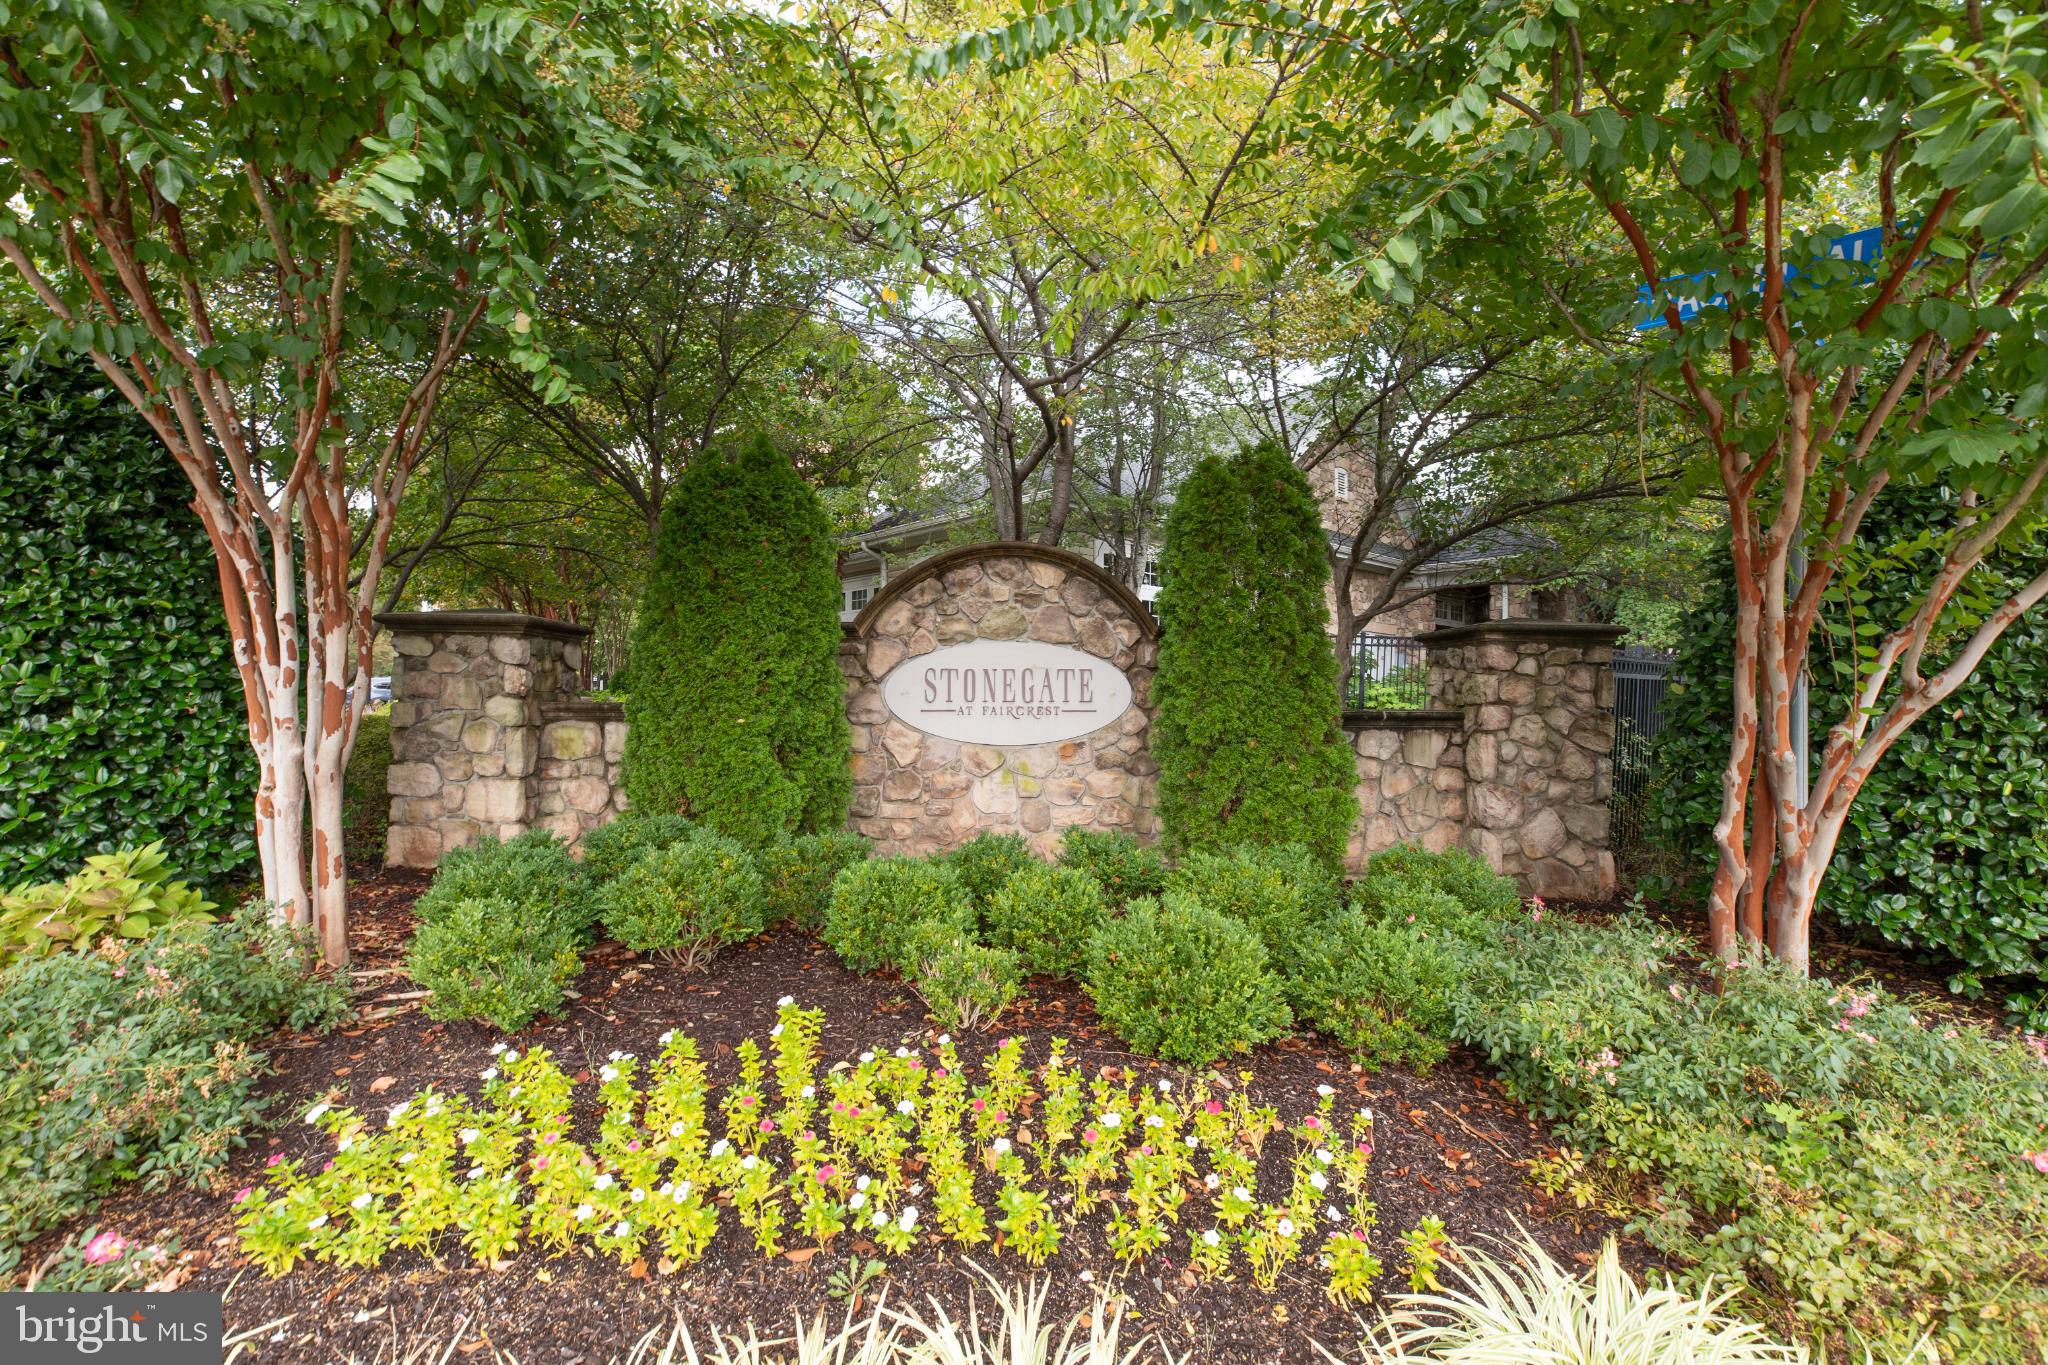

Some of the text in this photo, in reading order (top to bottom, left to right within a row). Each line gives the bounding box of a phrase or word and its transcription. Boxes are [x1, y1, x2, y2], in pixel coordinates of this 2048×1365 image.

[923, 667, 1094, 704] STONEGATE
[957, 705, 1061, 719] AT FAIRCREST
